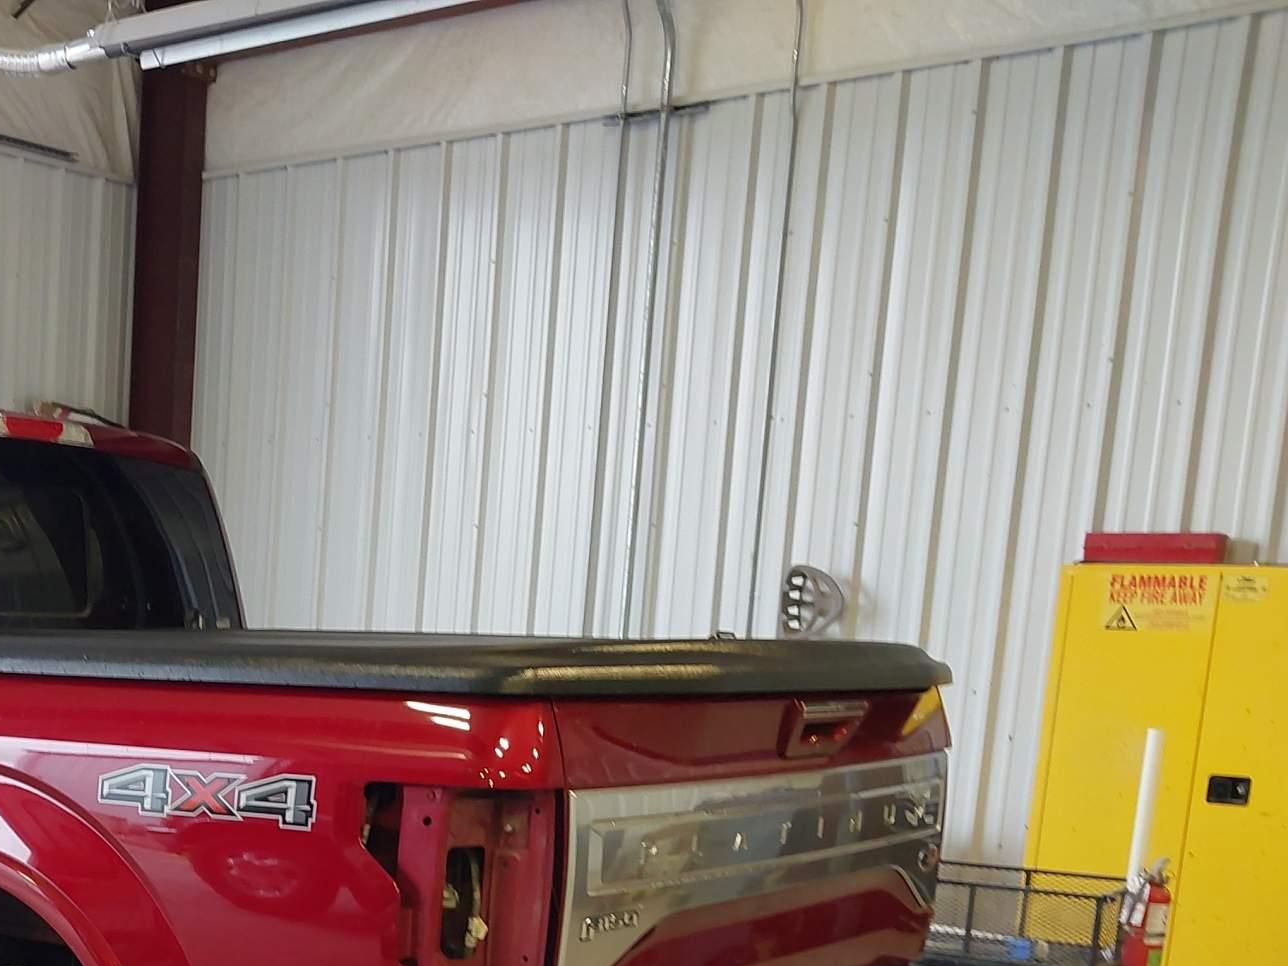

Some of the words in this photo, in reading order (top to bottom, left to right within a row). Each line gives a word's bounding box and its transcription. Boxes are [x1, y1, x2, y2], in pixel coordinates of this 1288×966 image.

[1110, 574, 1208, 592] FLAMMABLE
[1109, 590, 1137, 604] KEEP
[1140, 590, 1165, 605] FIRE
[1170, 590, 1203, 606] AWAY
